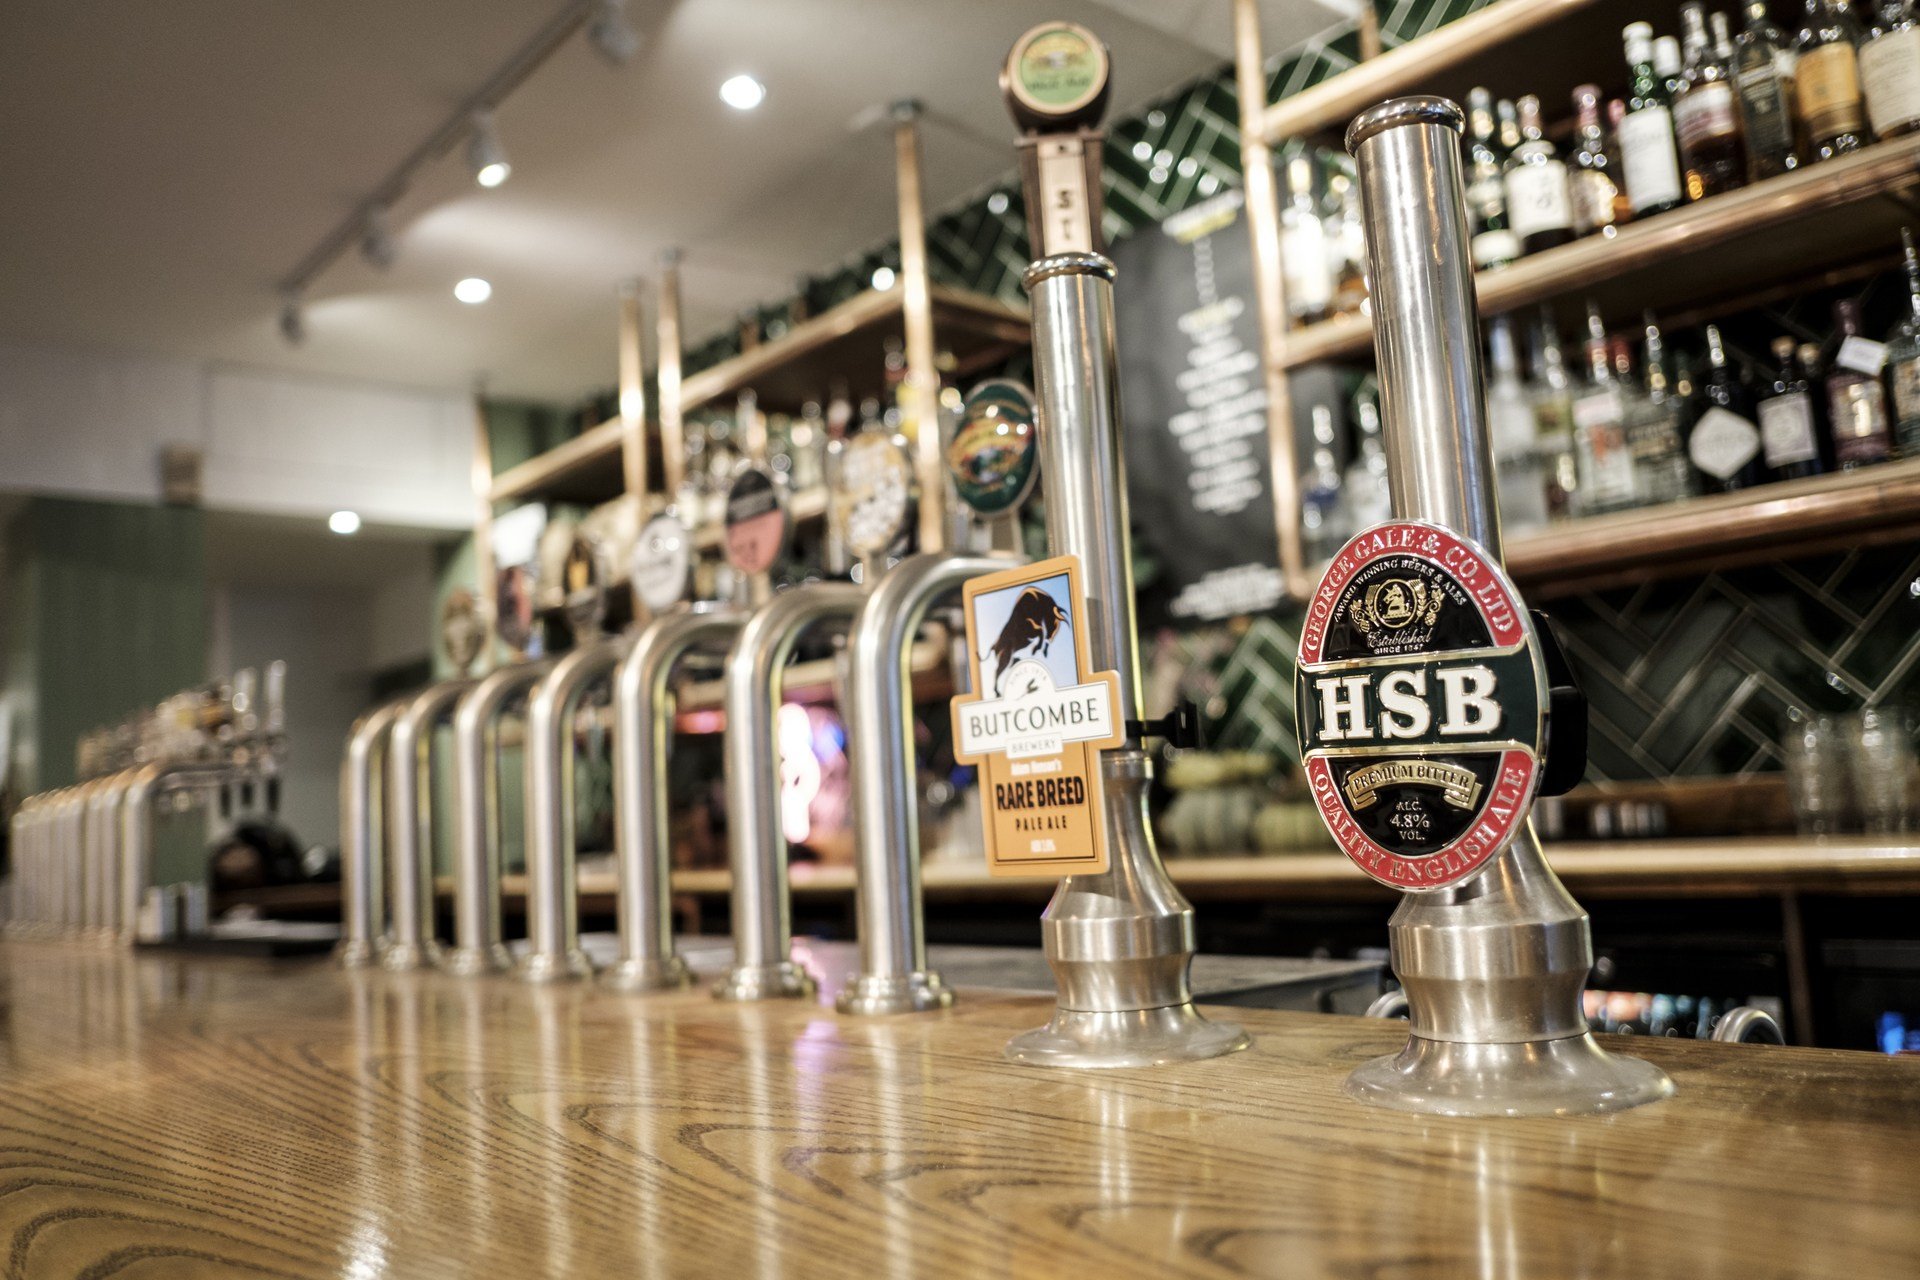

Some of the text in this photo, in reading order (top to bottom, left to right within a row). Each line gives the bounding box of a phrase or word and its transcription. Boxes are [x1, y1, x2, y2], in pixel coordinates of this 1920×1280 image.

[1305, 555, 1354, 651] GEORGE
[1355, 528, 1415, 559] GALE
[1421, 533, 1440, 554] &
[1477, 580, 1515, 632] LTD
[1334, 559, 1467, 623] AWARD WINNING BEERS & ALES
[1367, 627, 1433, 648] Established
[1373, 645, 1401, 655] SINCE
[1315, 664, 1502, 741] HSB
[969, 697, 1100, 738] BUTCOMBE
[1011, 739, 1056, 753] BREWERY
[1352, 764, 1470, 792] PREMIUM BITTER
[996, 776, 1084, 810] RARE BREED
[1396, 801, 1422, 811] ALC.
[1015, 815, 1068, 831] PALE ALE
[1314, 766, 1527, 881] QUALITY ENGLISH ALE
[1390, 813, 1431, 828] 4.8%
[1399, 830, 1426, 840] VOL.
